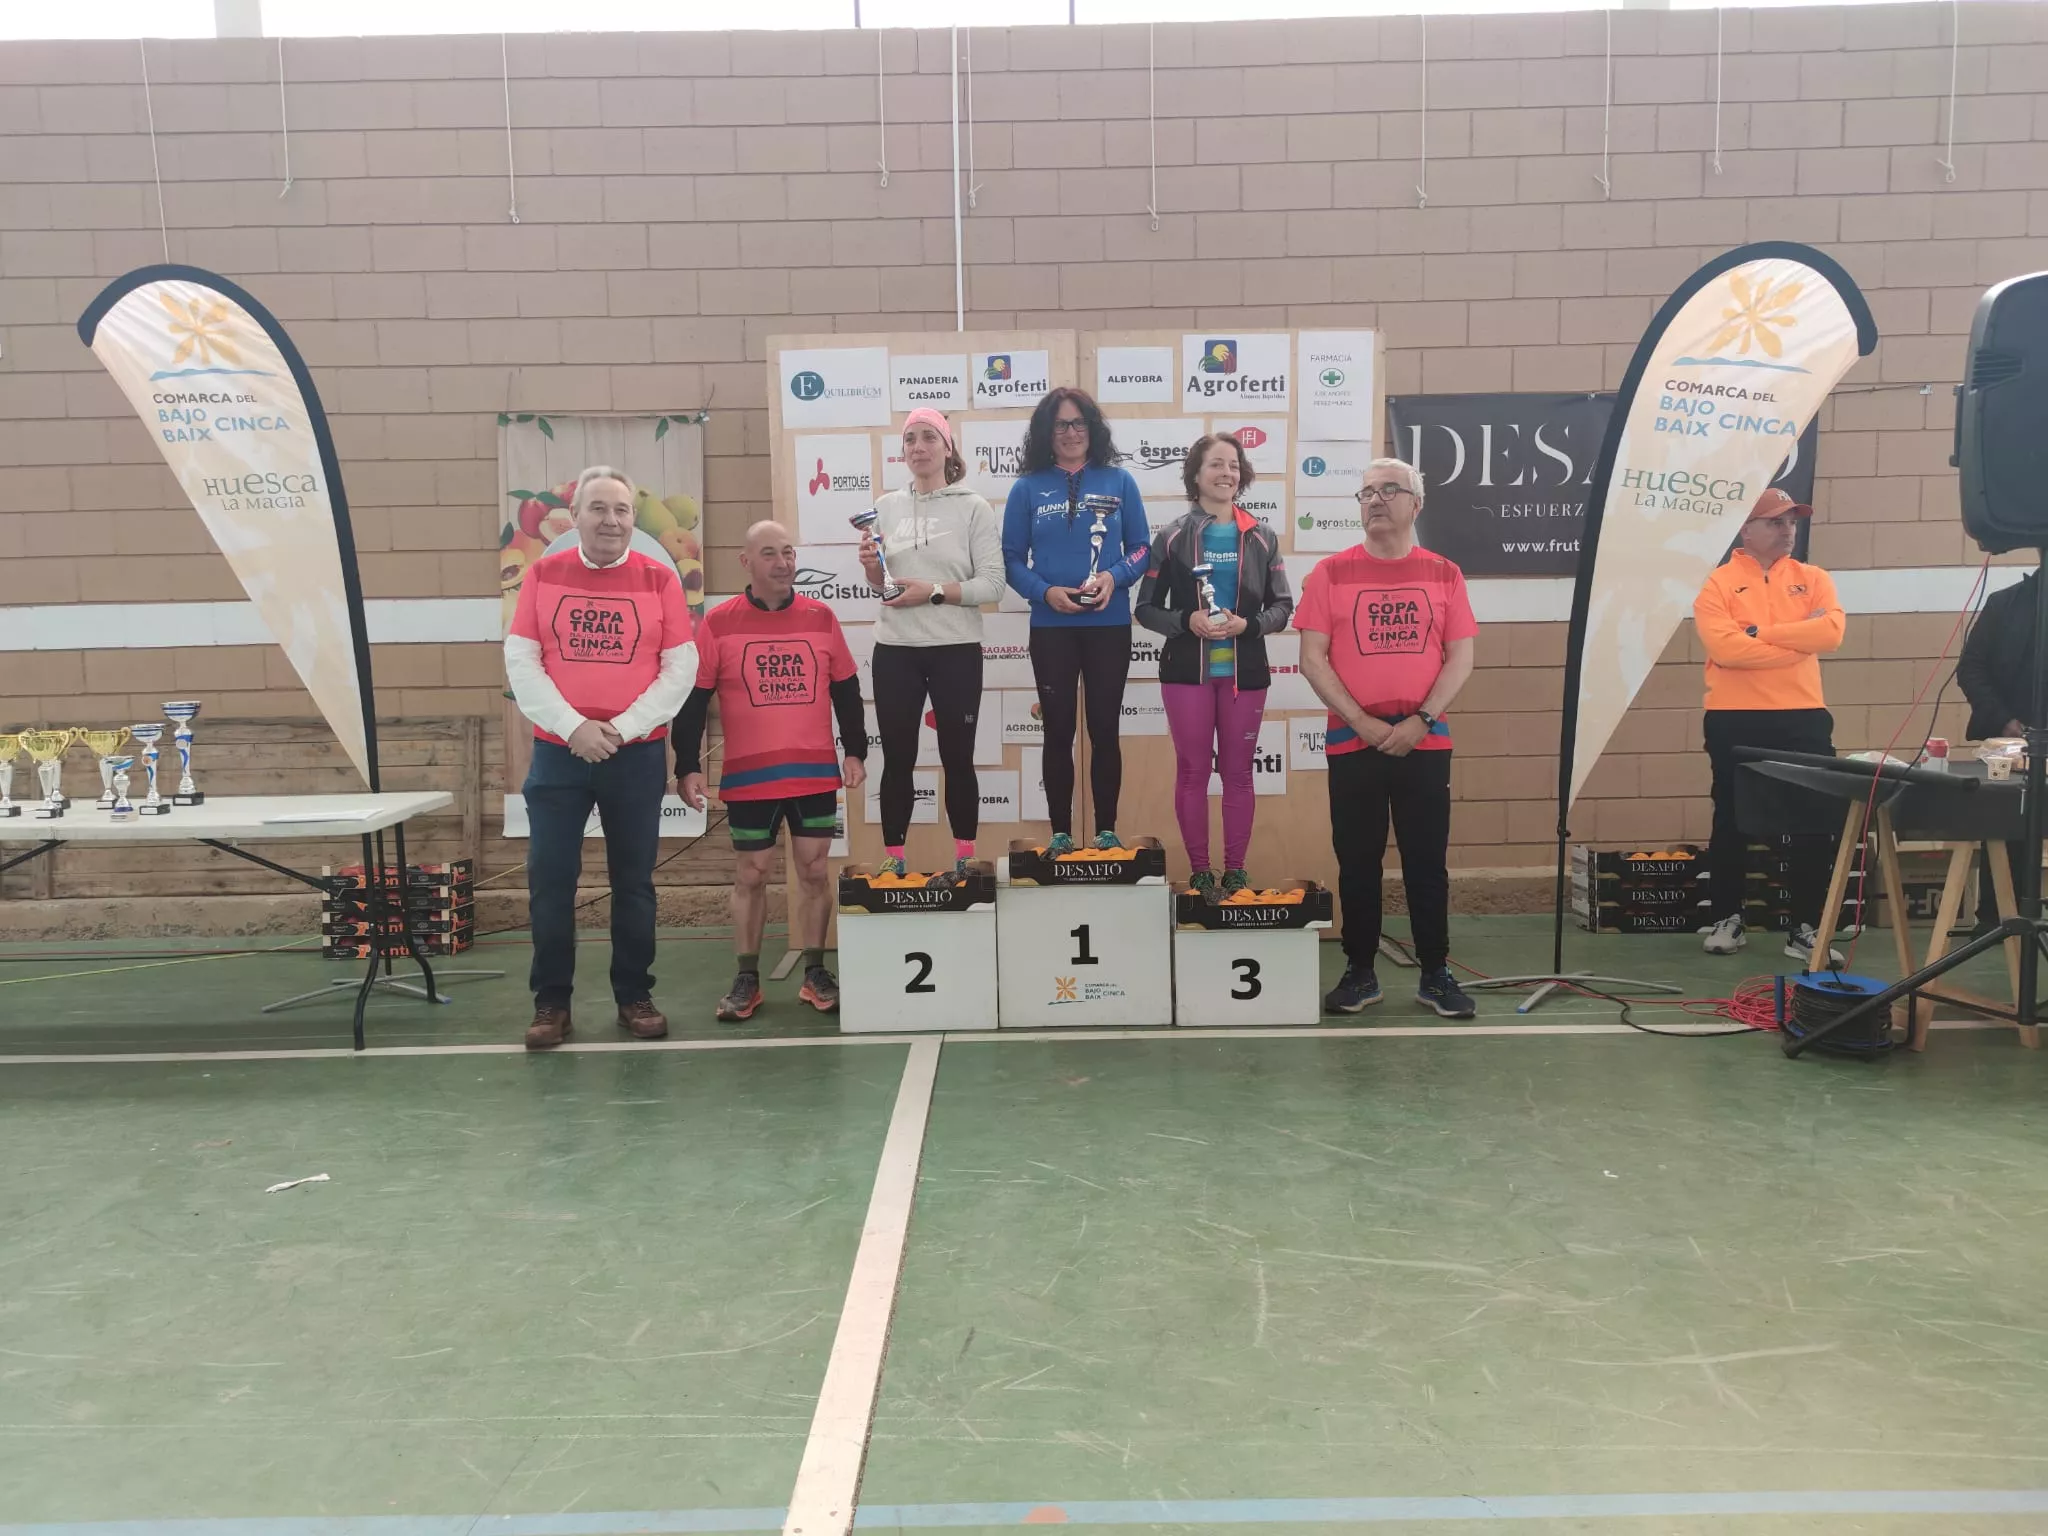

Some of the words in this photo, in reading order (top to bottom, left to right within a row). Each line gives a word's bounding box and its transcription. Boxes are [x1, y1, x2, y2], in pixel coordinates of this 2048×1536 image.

[1310, 354, 1352, 362] FARMACIA
[899, 376, 959, 385] PANADERIA
[1107, 374, 1163, 384] ALBYOBRA
[1186, 374, 1285, 397] Agroferti
[908, 391, 951, 400] CASADO
[976, 379, 1047, 397] Agroferti
[1665, 379, 1748, 400] COMARCA
[1752, 392, 1777, 403] DEL
[152, 392, 233, 405] COMARCA
[236, 393, 258, 404] DEL
[158, 408, 207, 425] BAJO
[214, 415, 291, 433] CINCA
[1659, 395, 1716, 417] BAJO
[1718, 413, 1797, 437] CINCA
[1654, 417, 1711, 437] BAIX
[162, 427, 214, 443] BAIX
[1140, 445, 1190, 460] espes
[1233, 502, 1278, 510] NADERIA
[1501, 503, 1585, 519] ESFUERZ
[1316, 518, 1363, 530] agrostoc
[1502, 538, 1581, 553] www.frut
[1368, 600, 1419, 615] COPA
[569, 608, 624, 624] COPA
[1368, 612, 1420, 627] TRAIL
[569, 620, 625, 635] TRAIL
[1368, 630, 1419, 642] CINCA
[569, 638, 623, 650] CINCA
[756, 653, 804, 667] COPA
[757, 665, 806, 678] TRAIL
[759, 682, 807, 694] CINCA
[1253, 753, 1282, 773] nti
[979, 796, 1010, 804] OBRA
[1070, 923, 1099, 965] 1
[904, 951, 936, 994] 2
[1230, 958, 1262, 1000] 3
